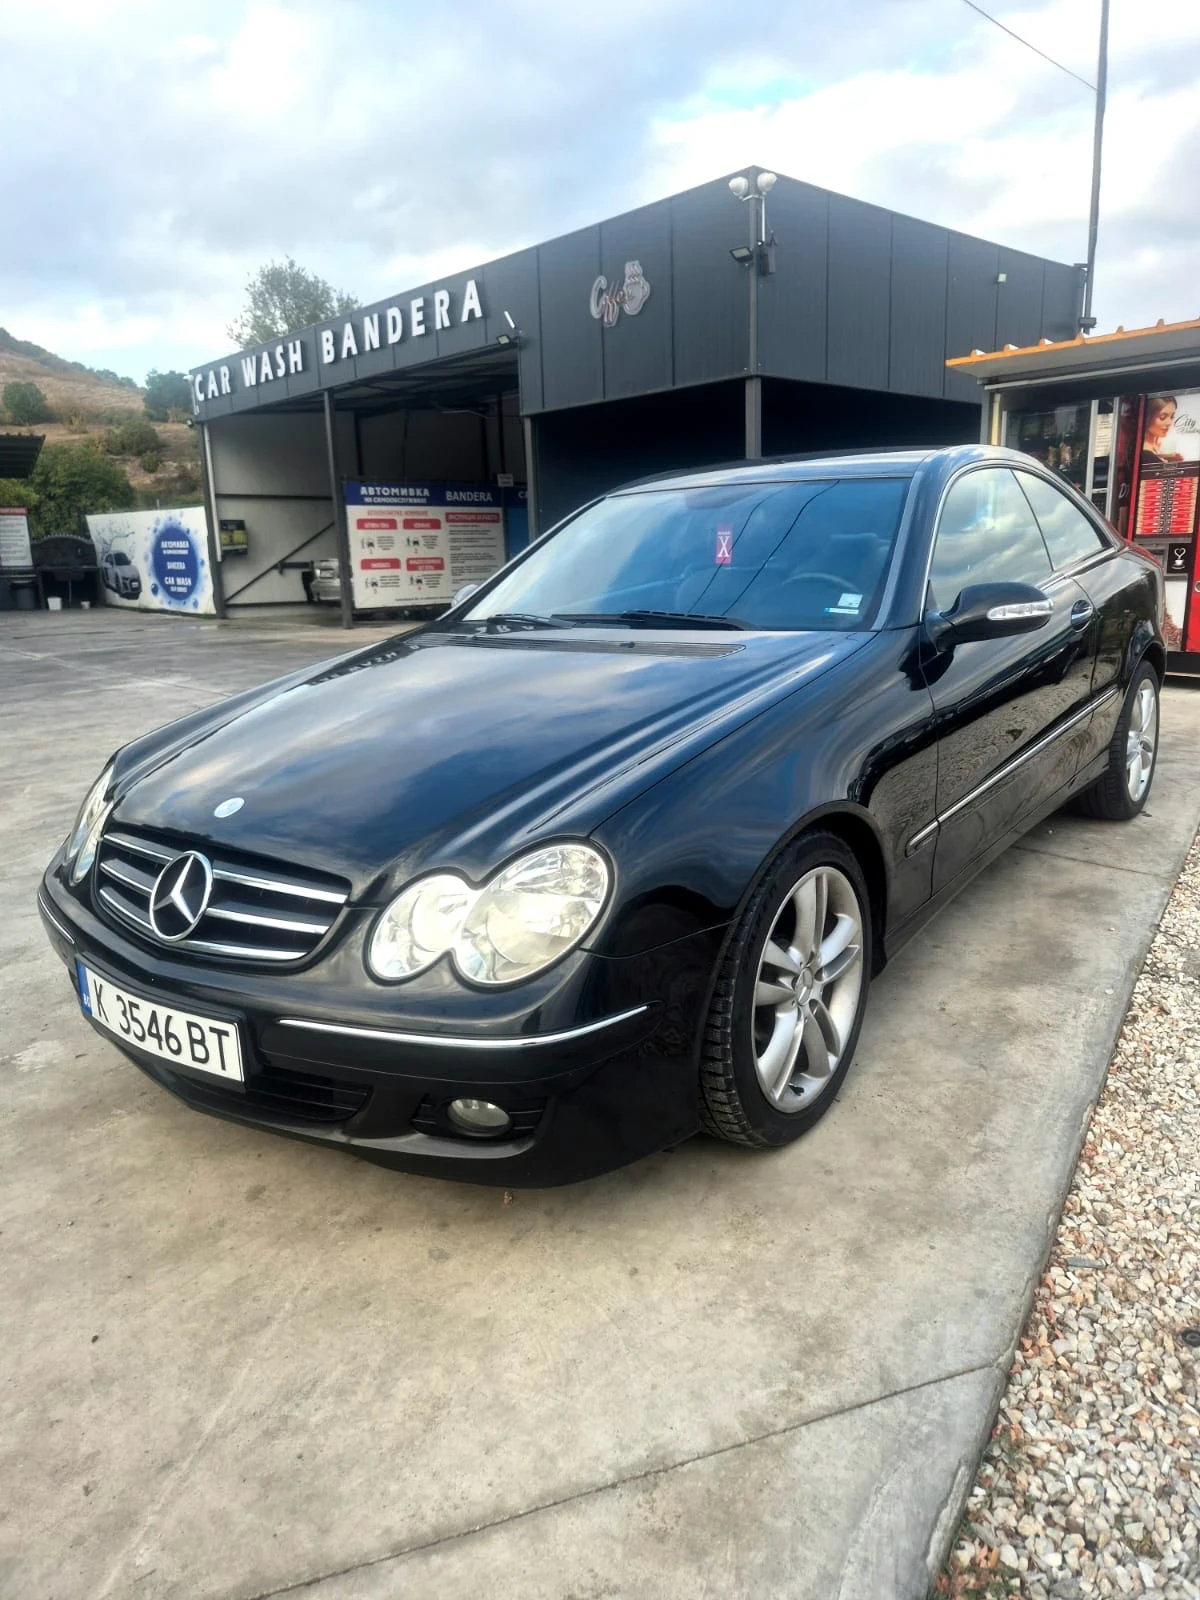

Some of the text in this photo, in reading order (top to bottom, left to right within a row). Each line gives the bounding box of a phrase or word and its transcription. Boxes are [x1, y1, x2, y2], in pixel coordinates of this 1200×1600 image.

[194, 279, 483, 402] CAR WASH BANDERA
[360, 486, 430, 497] АВТОМИВКА
[445, 490, 494, 502] BANDERA
[93, 978, 230, 1072] K 3546 BT
